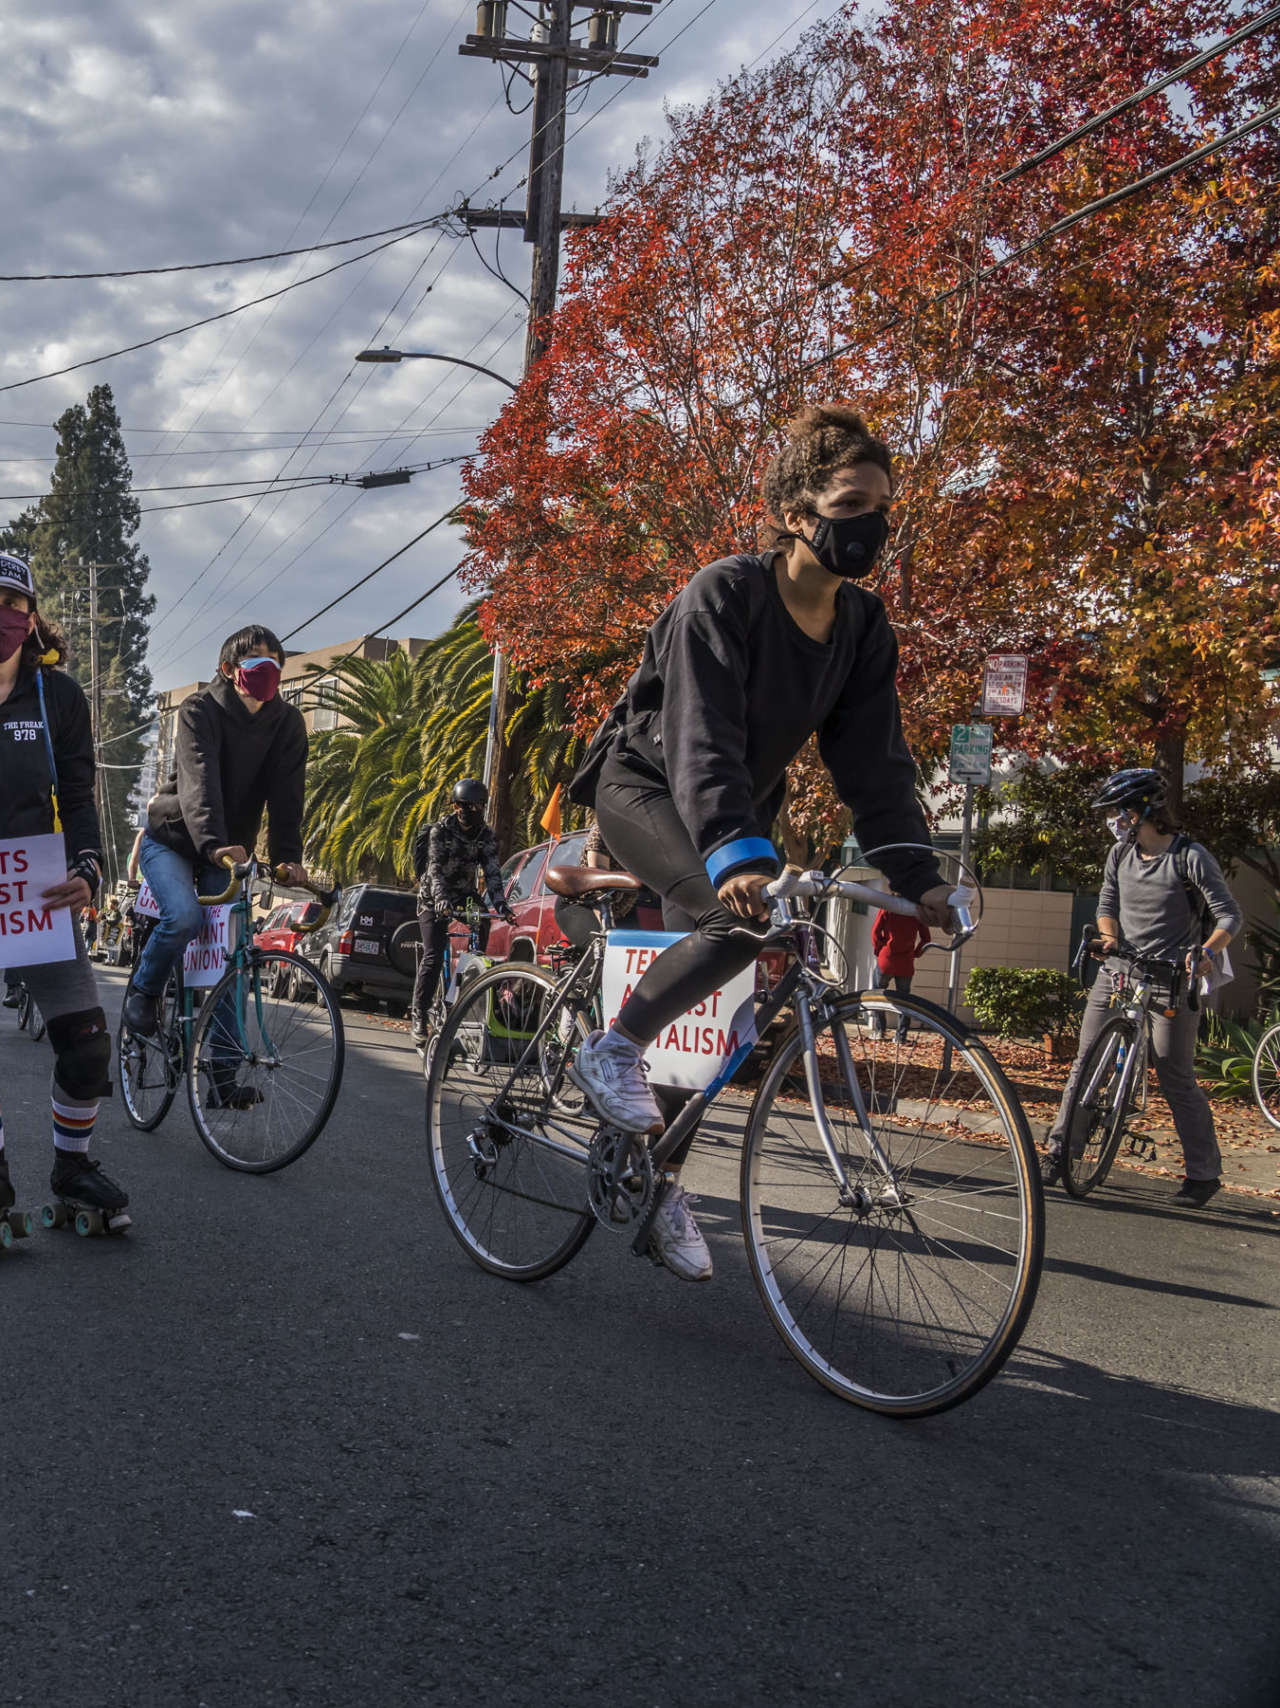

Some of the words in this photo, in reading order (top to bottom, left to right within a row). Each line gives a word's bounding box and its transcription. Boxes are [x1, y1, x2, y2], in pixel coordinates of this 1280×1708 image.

[3, 721, 19, 730] THE
[14, 729, 37, 741] 978
[956, 727, 967, 742] 2
[952, 744, 991, 754] PARKING
